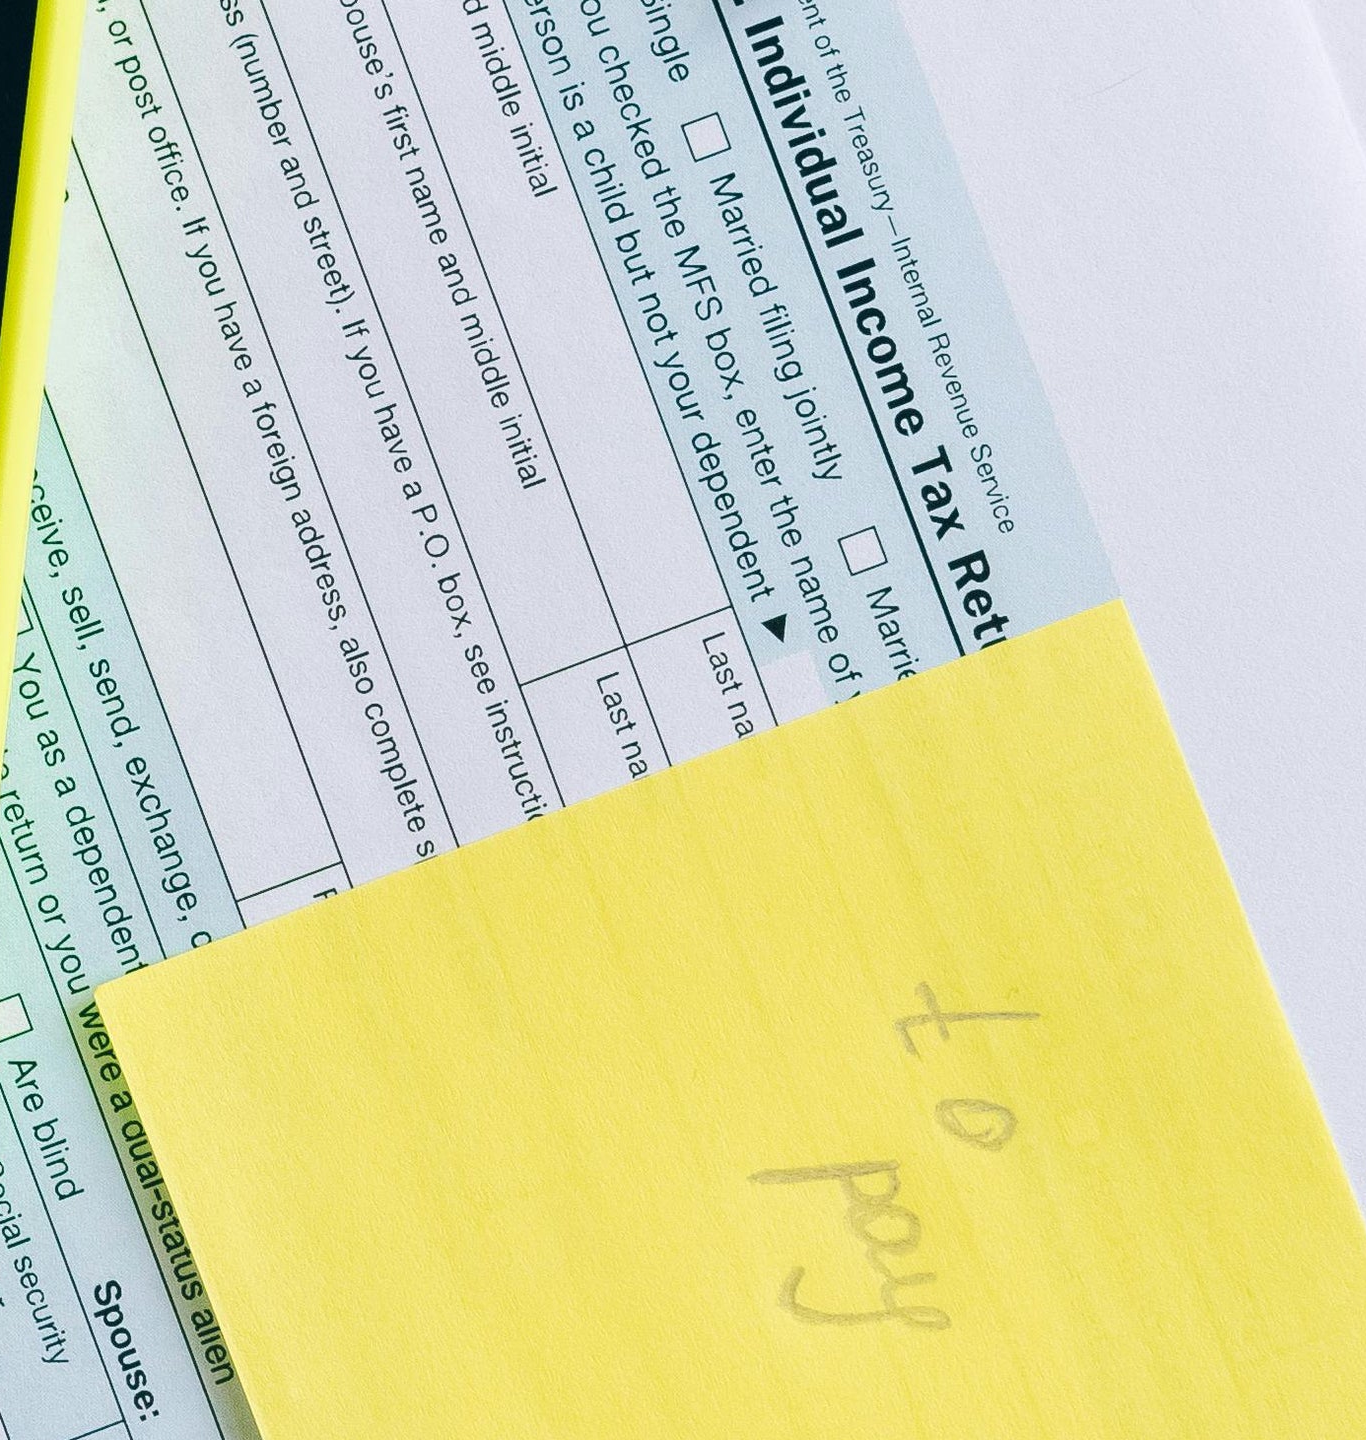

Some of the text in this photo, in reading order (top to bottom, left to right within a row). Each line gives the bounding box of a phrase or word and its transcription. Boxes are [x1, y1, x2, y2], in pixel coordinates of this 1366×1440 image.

[814, 35, 841, 58] of
[825, 63, 851, 103] the
[228, 33, 292, 147] (number
[470, 21, 523, 118] middle
[509, 121, 559, 198] initial
[558, 81, 586, 112] is
[572, 119, 596, 142] a
[279, 156, 321, 210] and
[583, 147, 635, 225] child
[302, 215, 356, 315] street).
[614, 228, 656, 287] but
[341, 318, 371, 338] If
[382, 103, 421, 162] first
[404, 166, 448, 246] name
[437, 252, 478, 307] and
[459, 312, 511, 409] middle
[498, 412, 547, 490] initial
[637, 291, 679, 347] not
[709, 171, 844, 480] Married filing jointly
[744, 15, 865, 249] Individual
[836, 257, 925, 437] Income
[911, 444, 965, 542] Tax
[947, 549, 1010, 649] Ret
[344, 345, 386, 400] you
[598, 45, 672, 181] checked
[652, 184, 686, 239] the
[673, 244, 724, 322] MFS
[704, 326, 745, 401] box,
[735, 408, 783, 487] enter
[769, 494, 803, 549] the
[789, 555, 839, 645] name
[827, 652, 864, 684] of
[652, 350, 705, 421] your
[927, 331, 979, 440] Revenue
[373, 402, 413, 474] have
[401, 480, 423, 501] a
[690, 431, 776, 604] dependent
[969, 443, 1015, 534] Service
[410, 502, 450, 569] P.O.
[436, 572, 472, 639] box,
[464, 643, 496, 695] see
[12, 651, 50, 721] You
[36, 729, 67, 768] as
[53, 776, 77, 799] a
[6, 1060, 86, 1202] Are blind
[13, 1255, 70, 1364] security
[92, 1279, 160, 1422] Spouse:
